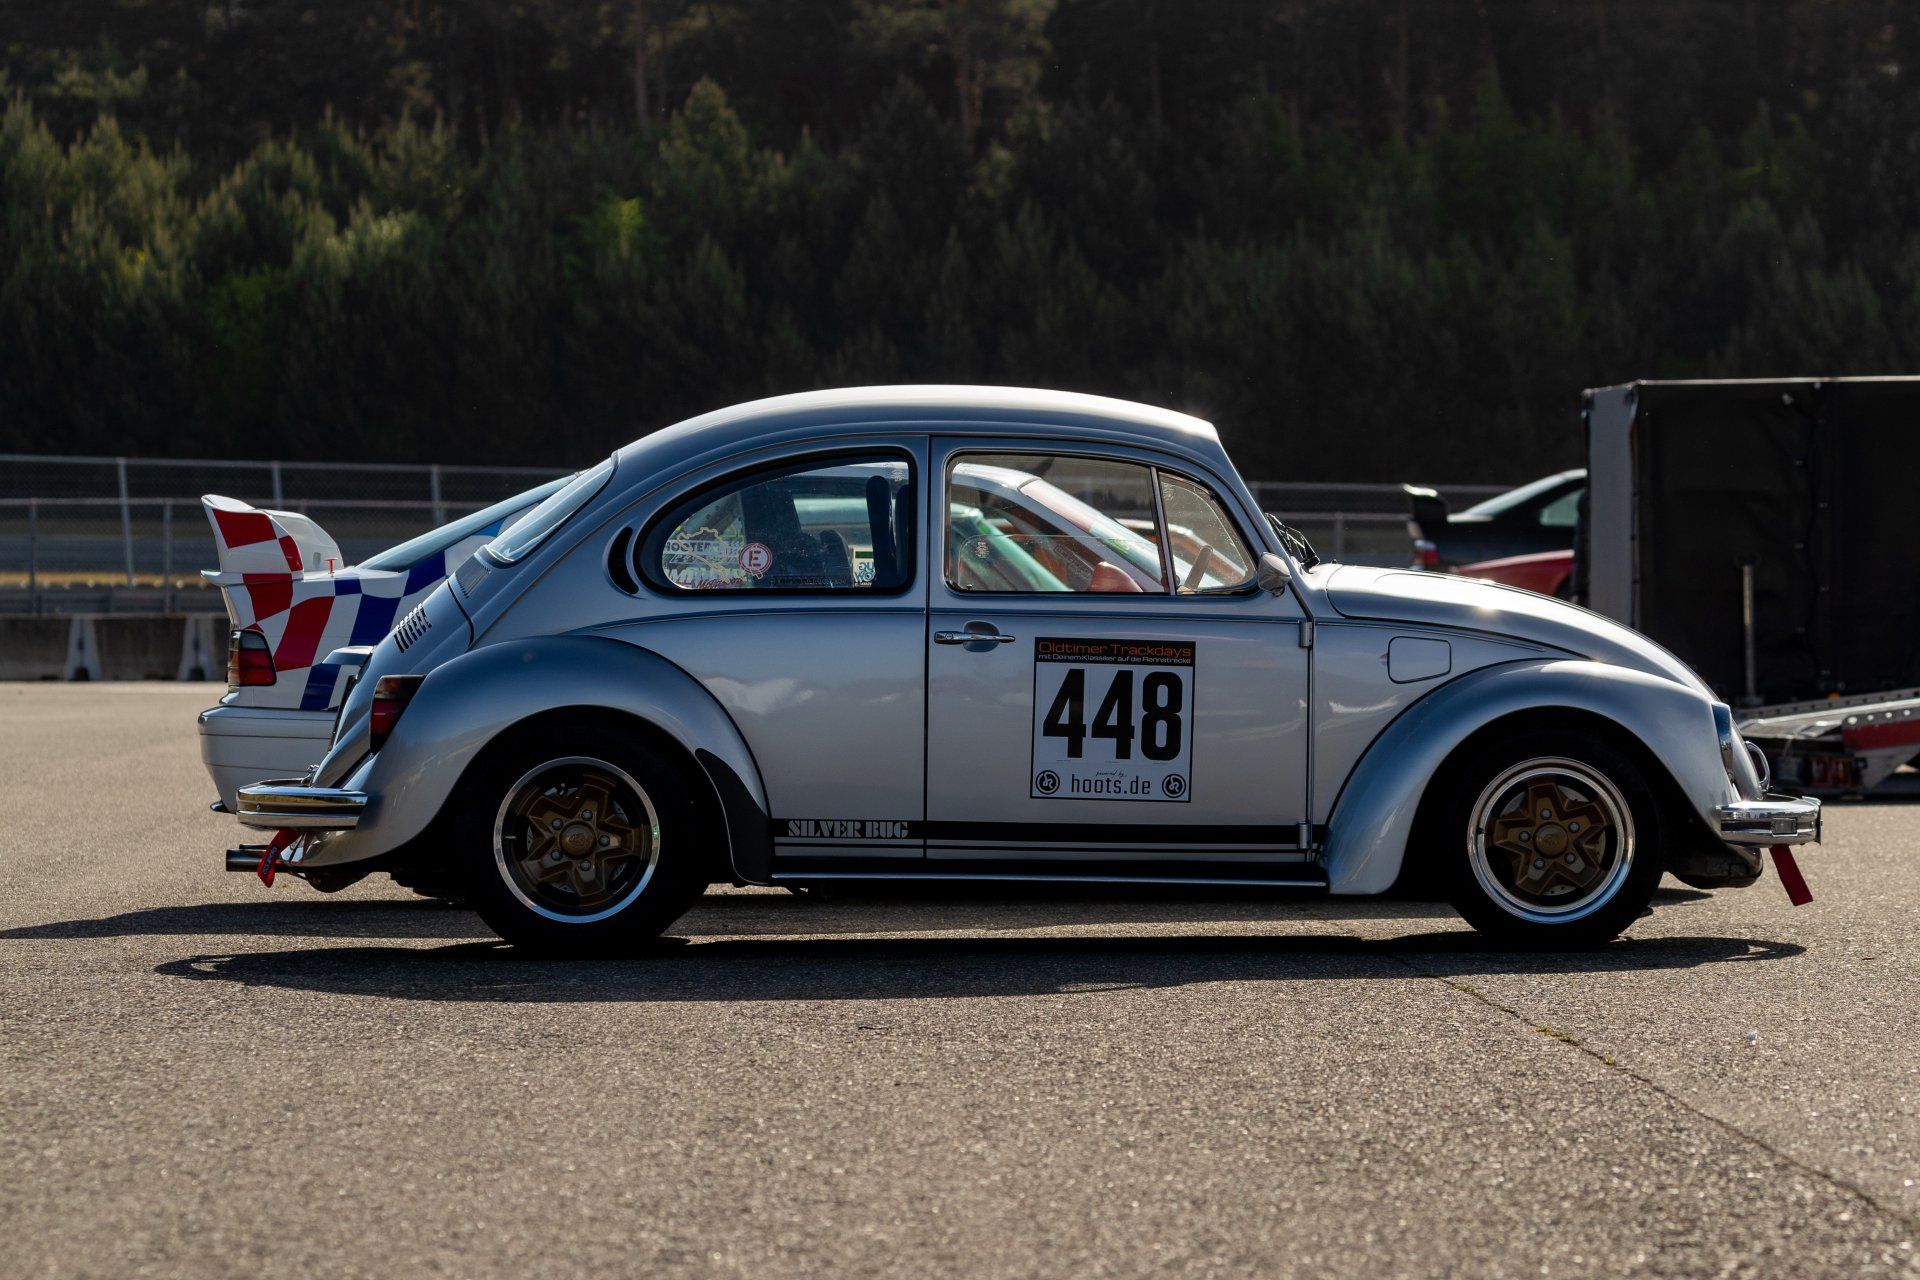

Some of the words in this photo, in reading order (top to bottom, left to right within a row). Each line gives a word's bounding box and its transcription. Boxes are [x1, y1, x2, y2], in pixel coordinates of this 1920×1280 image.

[749, 551, 761, 566] E
[1038, 641, 1108, 654] Oldtimer
[1110, 643, 1192, 658] Trackdays
[1052, 653, 1082, 661] Deinem
[1082, 654, 1117, 662] Klassiker
[1142, 656, 1192, 665] Rennstrecke
[1043, 668, 1183, 761] 448
[1071, 773, 1151, 795] hoots.de
[788, 819, 862, 838] SILVER
[865, 820, 909, 839] BUG
